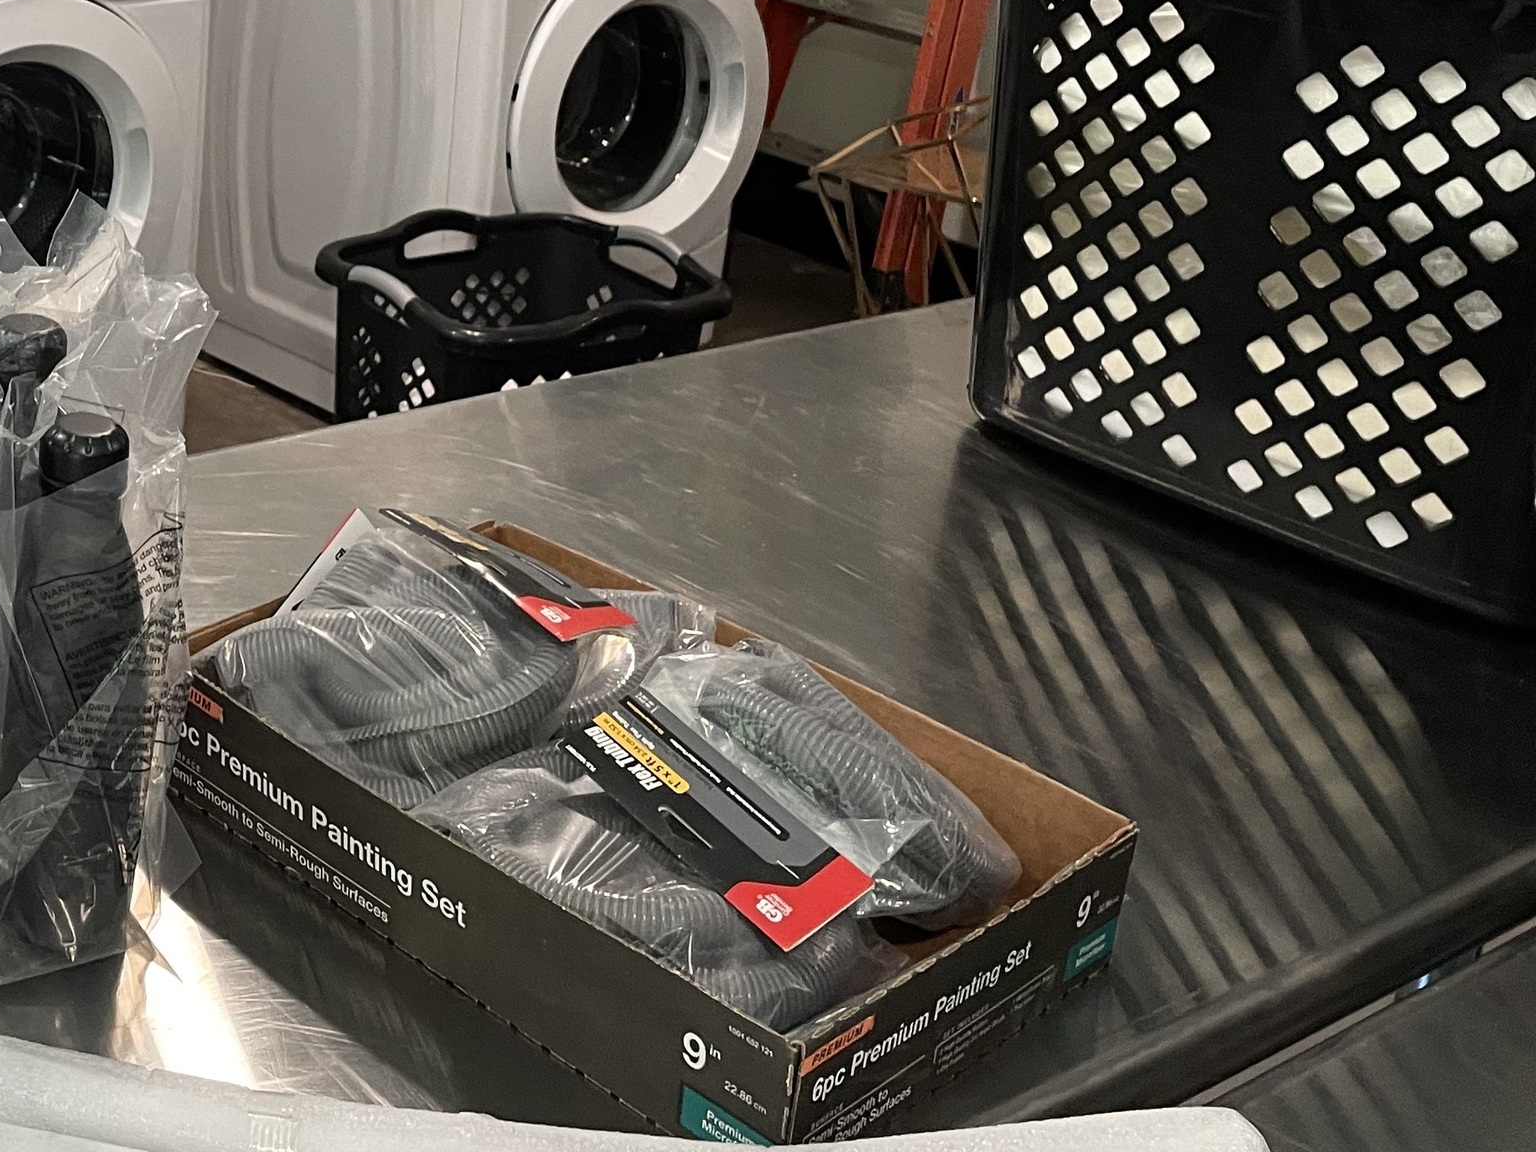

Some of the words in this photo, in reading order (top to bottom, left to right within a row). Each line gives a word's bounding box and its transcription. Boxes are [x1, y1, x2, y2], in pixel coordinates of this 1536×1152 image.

[584, 725, 635, 768] Tubing
[645, 756, 657, 766] ft
[626, 763, 663, 791] Flex
[653, 765, 663, 774] 5
[172, 765, 239, 821] emi-Smooth
[241, 810, 254, 830] to
[255, 820, 330, 884] Semi-Rough
[331, 874, 390, 925] Surfaces
[206, 731, 305, 822] Premium
[311, 804, 414, 898] Painting
[420, 877, 467, 930] Set
[1076, 894, 1092, 928] 9
[812, 1067, 846, 1102] 6pc
[850, 1011, 930, 1077] Premium
[933, 963, 1002, 1022] Painting
[1004, 940, 1032, 973] Set
[682, 1032, 707, 1070] 9
[709, 1043, 722, 1060] in
[811, 1023, 865, 1066] PREMIUM
[868, 1085, 912, 1122] Surfaces
[877, 1089, 889, 1103] to
